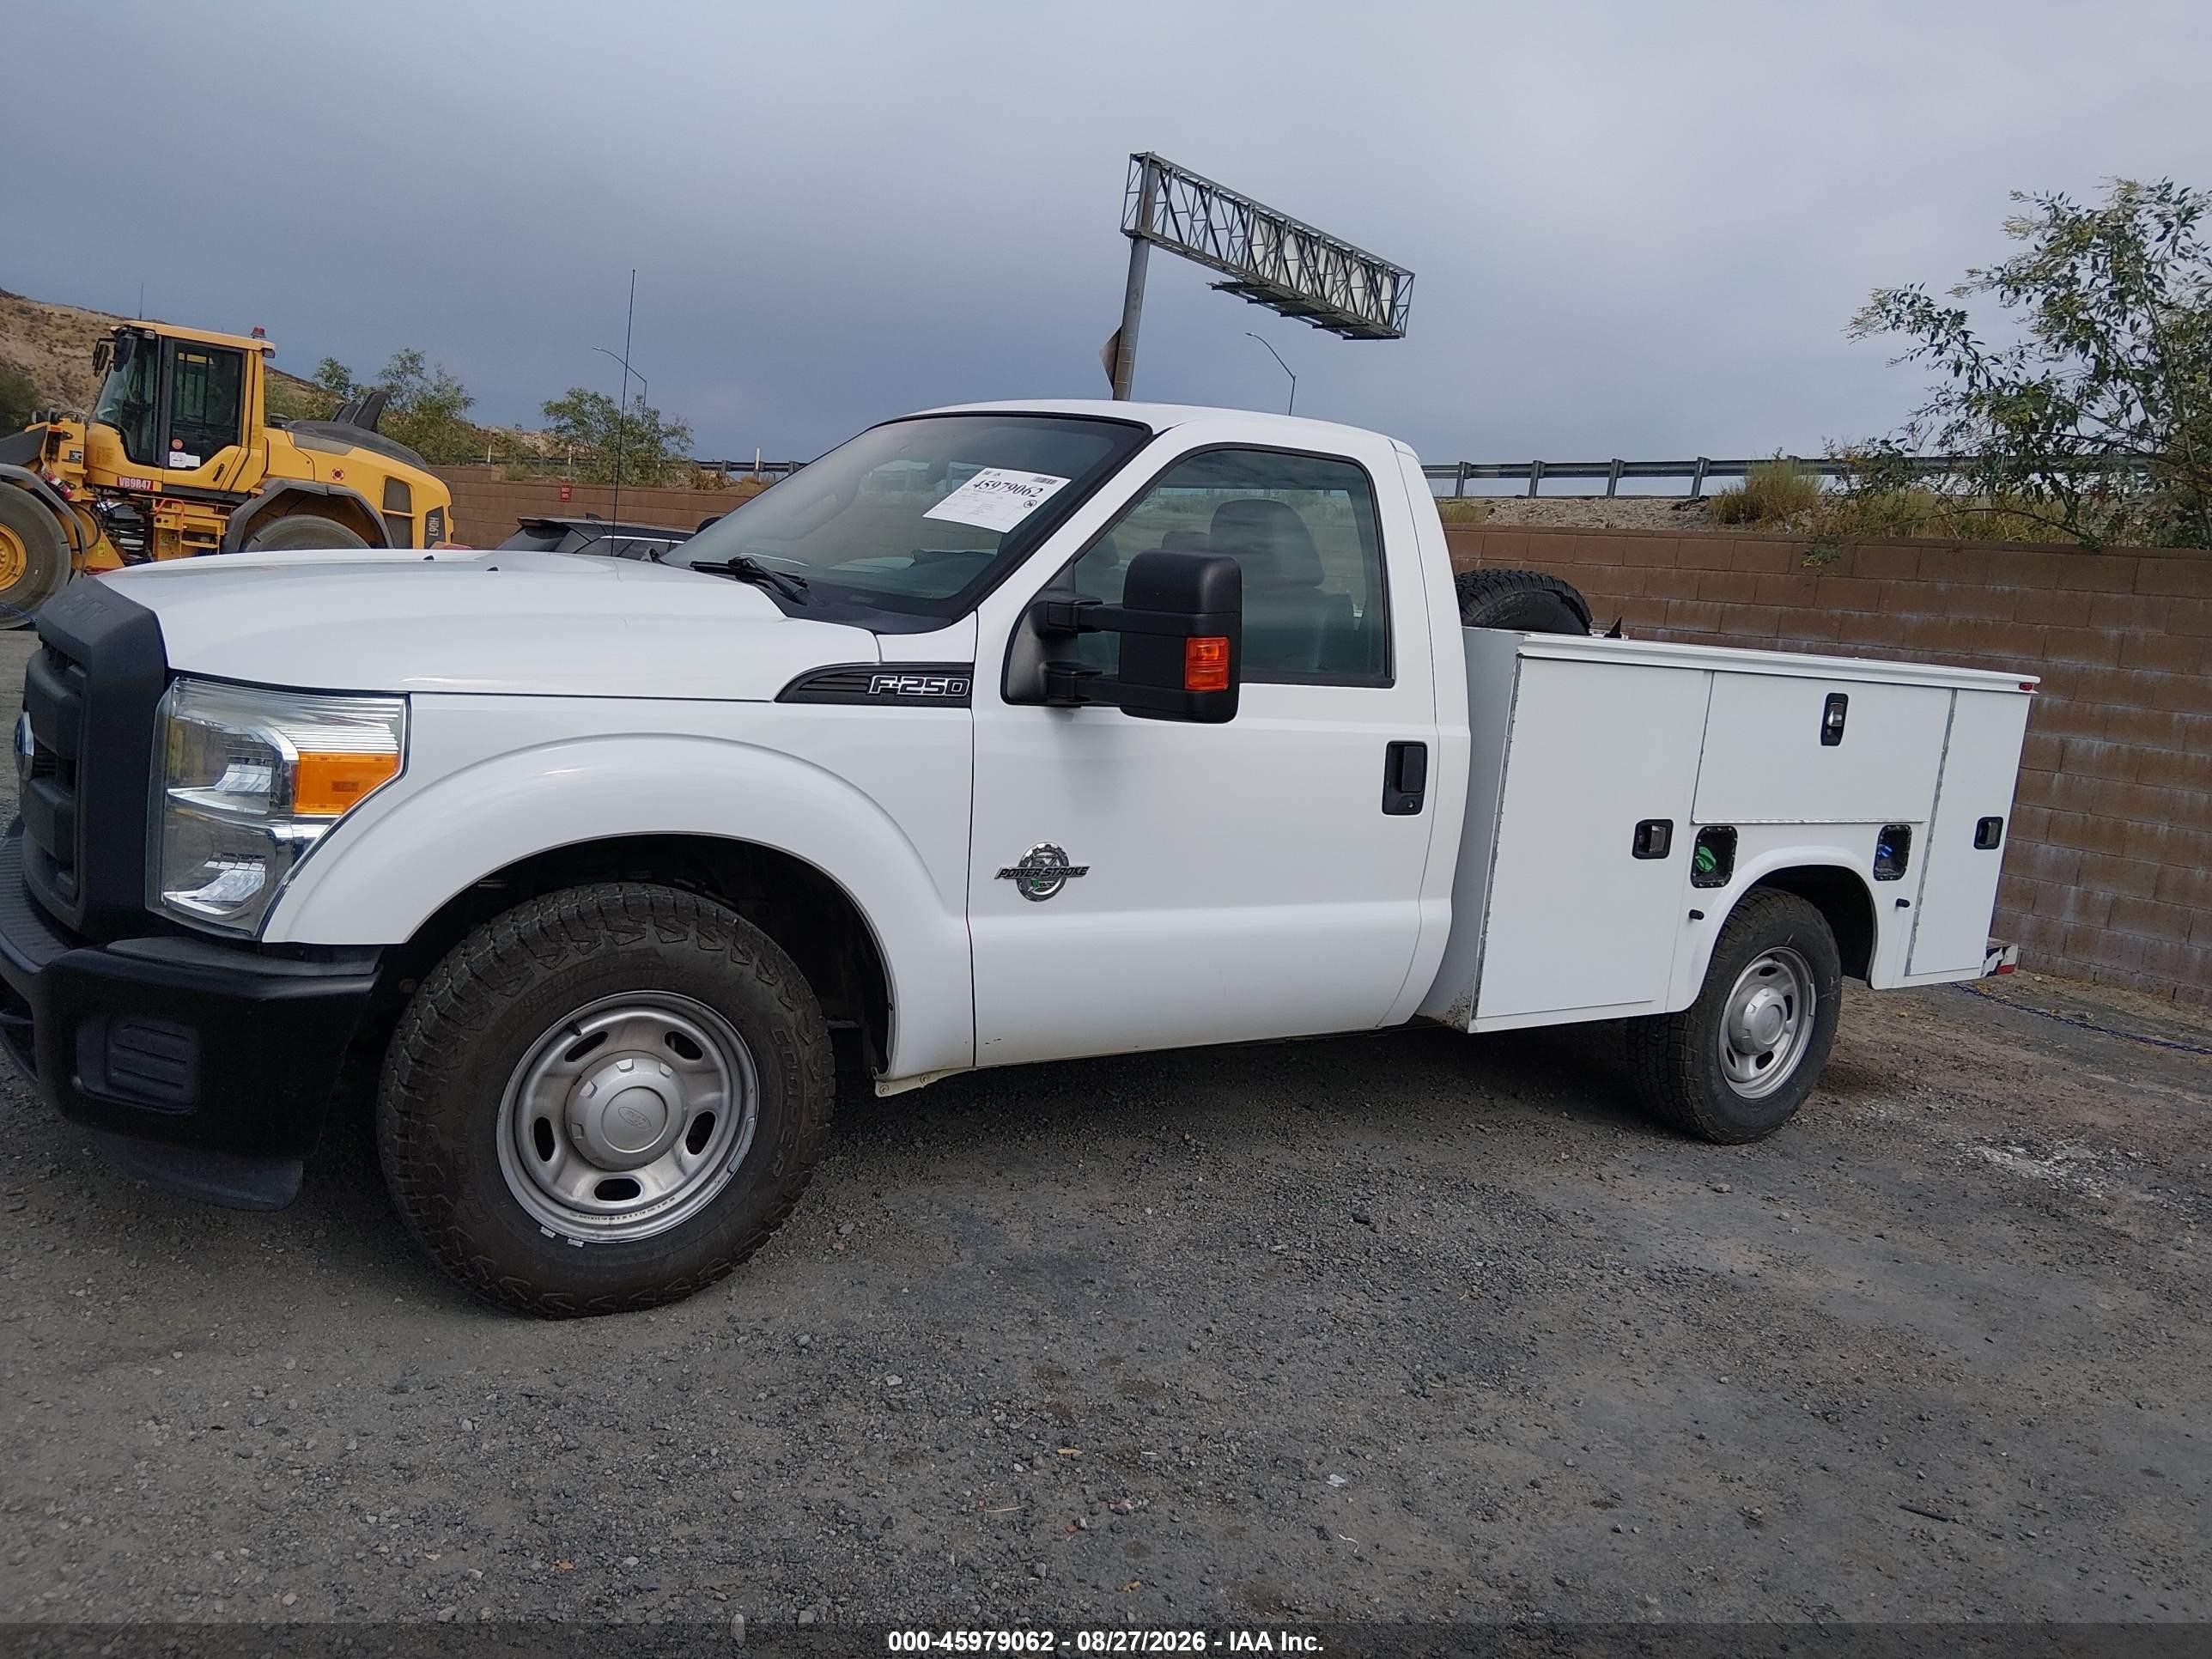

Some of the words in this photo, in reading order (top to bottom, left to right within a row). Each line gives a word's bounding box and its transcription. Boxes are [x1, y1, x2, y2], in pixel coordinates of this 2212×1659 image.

[972, 479, 1044, 498] 45979062
[428, 517, 440, 537] L90H
[869, 674, 970, 696] F-250
[996, 867, 1042, 878] POWER
[1041, 866, 1090, 878] STROKE
